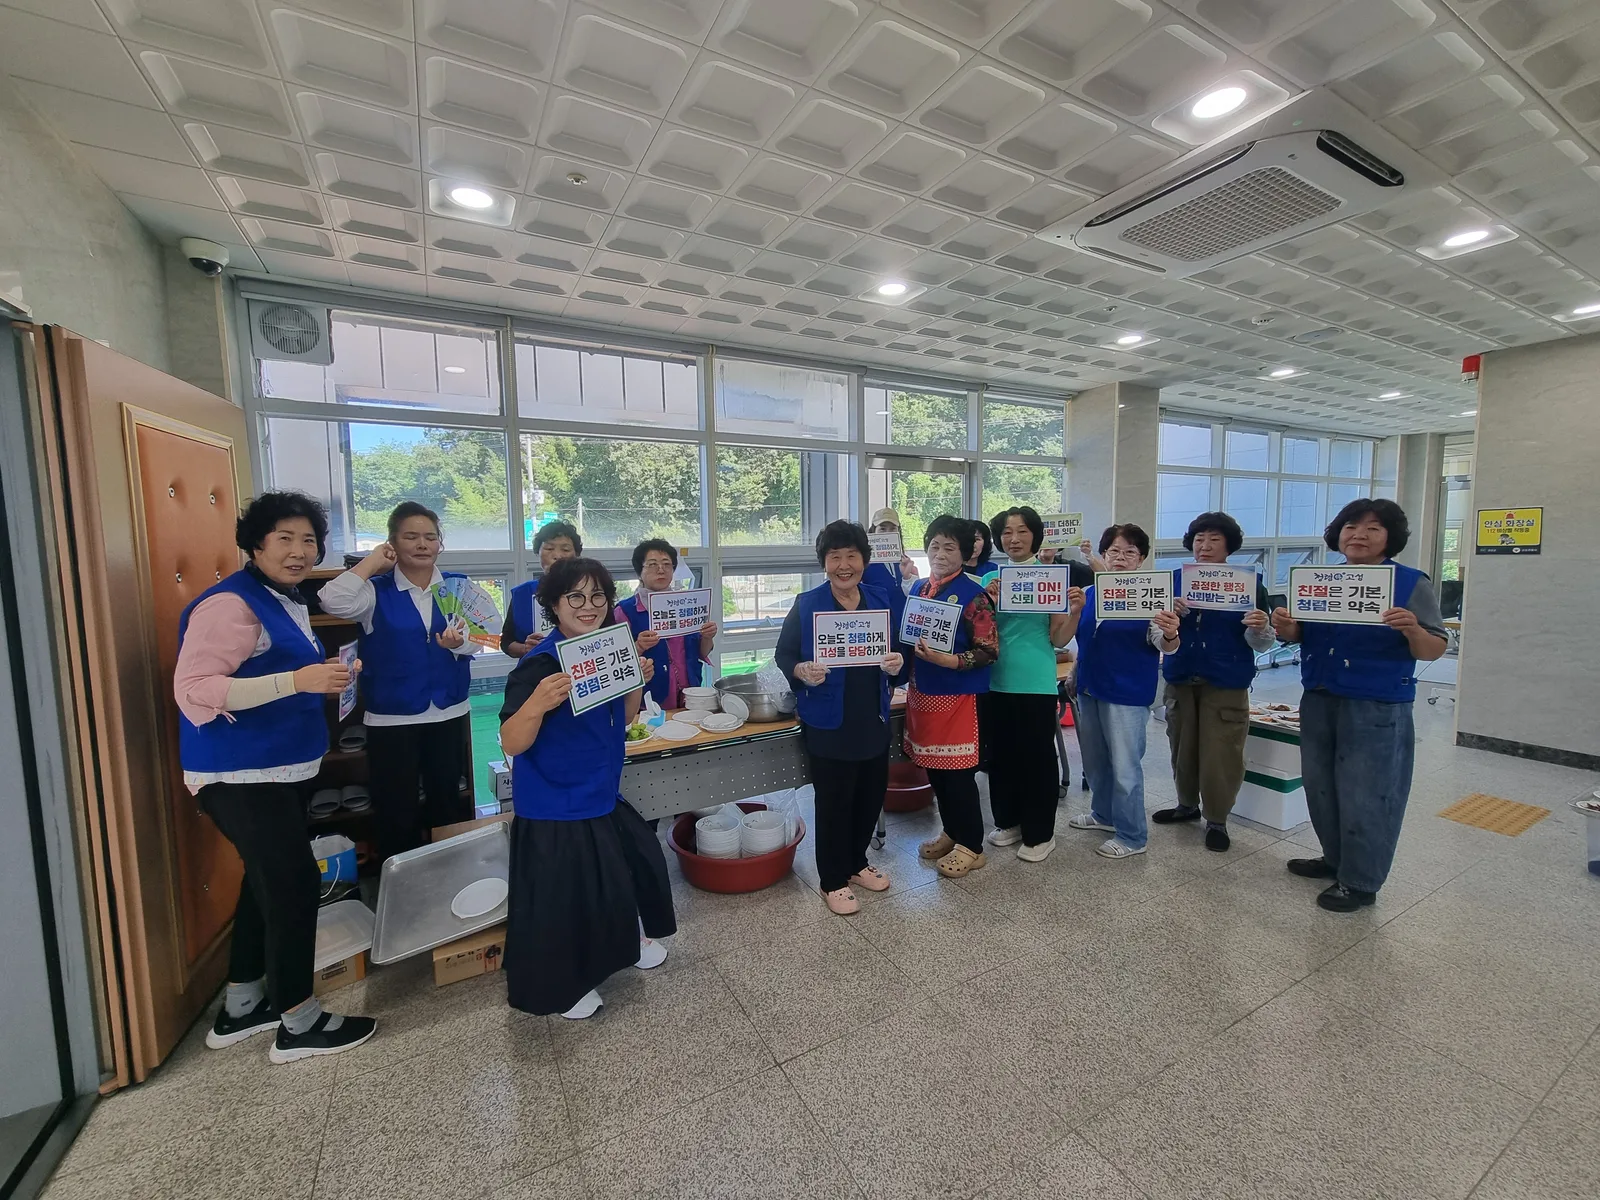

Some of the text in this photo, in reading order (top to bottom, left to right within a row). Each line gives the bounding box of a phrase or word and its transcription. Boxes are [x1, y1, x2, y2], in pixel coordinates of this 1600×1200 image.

[1484, 519, 1534, 528] 안심 화장실
[1345, 573, 1364, 581] 고성
[1011, 582, 1061, 592] 청렴 ON!
[1191, 580, 1245, 592] 공정한 행정
[1298, 584, 1386, 599] 친절은 기본,
[1011, 594, 1061, 604] 신뢰 UP!
[1103, 587, 1168, 599] 친절은 기본,
[1186, 591, 1250, 604] 신뢰받는 고성
[1103, 600, 1165, 611] 청렴은 약속
[1297, 599, 1380, 614] 청렴은 약속
[653, 609, 676, 620] 오늘도
[653, 620, 676, 631] 고성을
[908, 613, 953, 633] 친절은 기본,
[818, 632, 886, 645] 오늘도 청렴하게,
[906, 625, 949, 645] 청렴은 약속
[819, 645, 887, 658] 고성을 당당하게!
[571, 647, 634, 680] 친절은 기본,
[575, 665, 635, 698] 청렴은 약속
